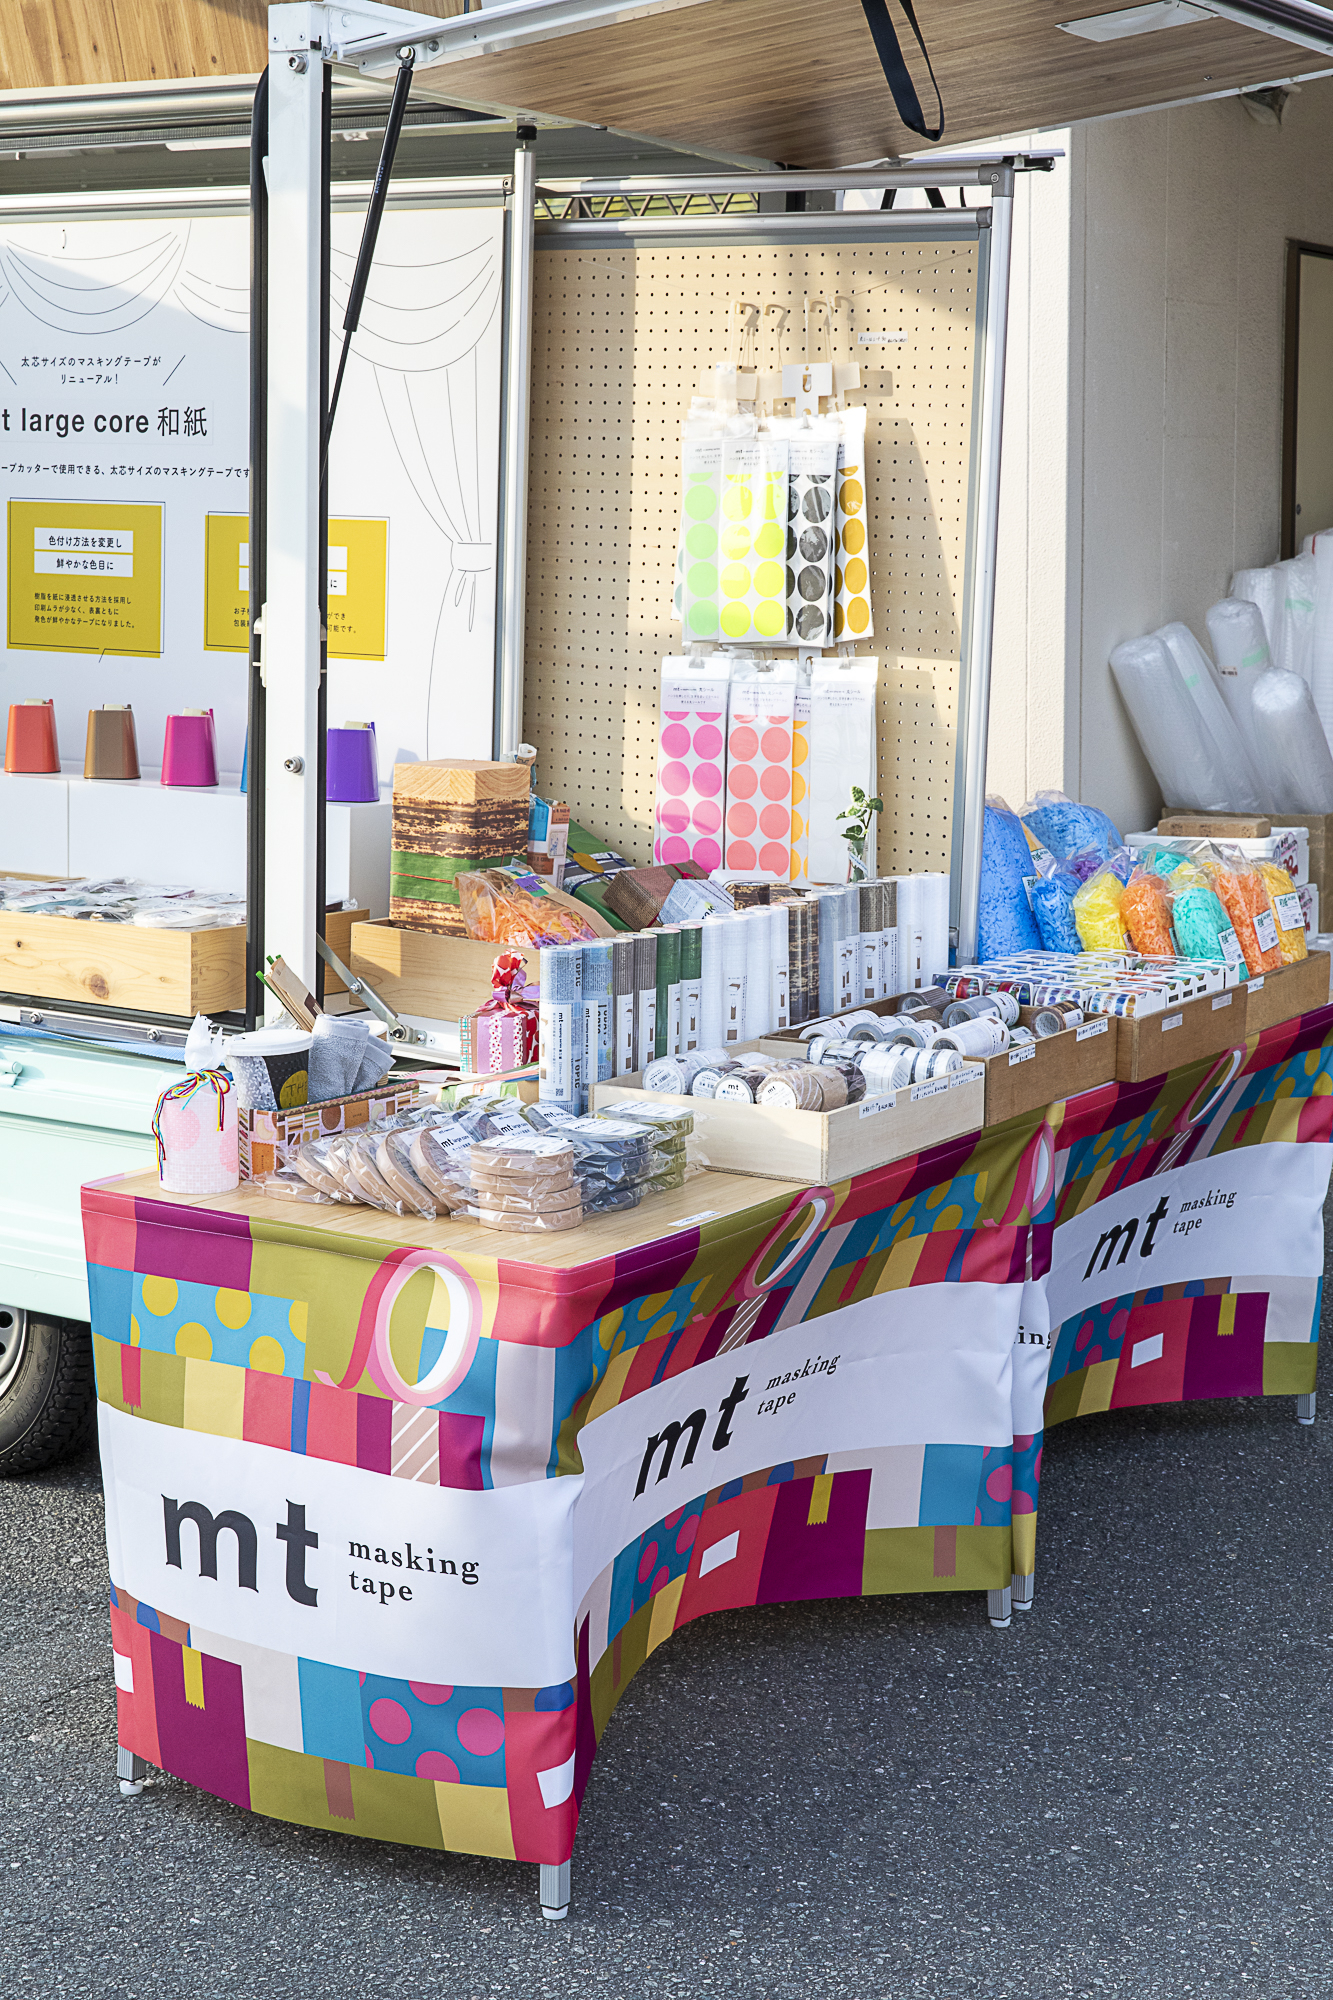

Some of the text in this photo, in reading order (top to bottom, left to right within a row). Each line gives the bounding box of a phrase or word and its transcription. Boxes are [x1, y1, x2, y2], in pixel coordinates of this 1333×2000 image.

[21, 356, 162, 367] 太芯サイズのマスキングテープが
[22, 407, 85, 438] large
[94, 414, 149, 433] core
[157, 406, 207, 437] 和紙
[48, 535, 122, 548] 色付け方法を変更し
[56, 558, 114, 570] 鮮やかな色目に
[558, 1012, 564, 1023] mt
[728, 1083, 739, 1091] mt
[500, 1124, 514, 1134] mt
[441, 1137, 454, 1148] mt
[1179, 1189, 1237, 1213] masking
[1172, 1216, 1202, 1236] tape
[1081, 1195, 1170, 1282] mt
[765, 1354, 841, 1391] masking
[757, 1391, 796, 1415] tape
[633, 1373, 750, 1502] mt
[160, 1493, 319, 1608] mt
[348, 1539, 480, 1585] masking
[348, 1570, 414, 1605] tape
